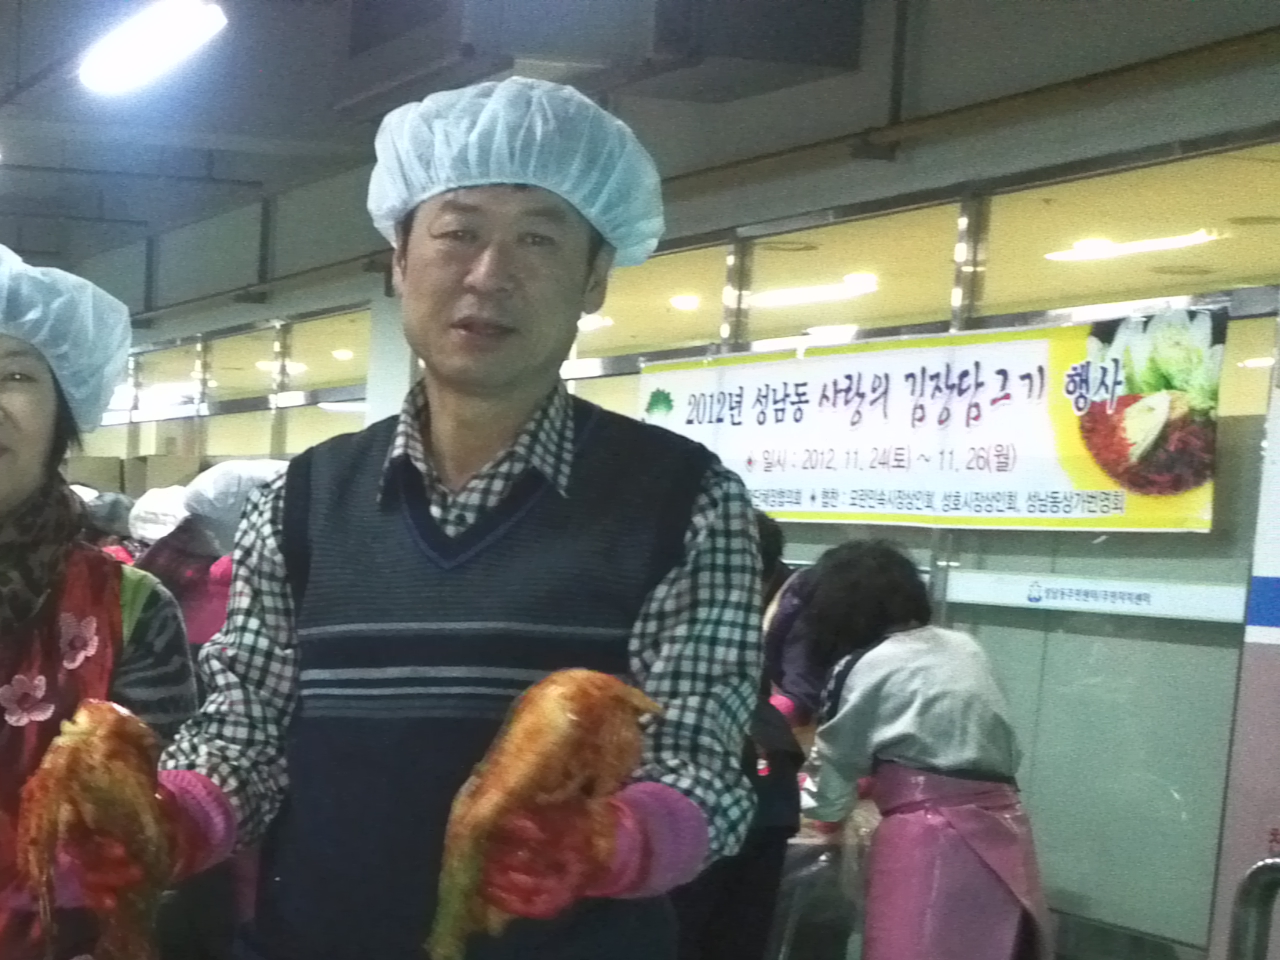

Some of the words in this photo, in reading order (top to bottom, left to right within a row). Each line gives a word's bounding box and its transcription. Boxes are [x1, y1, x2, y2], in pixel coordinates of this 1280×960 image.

[685, 386, 745, 426] 2012년
[752, 381, 810, 426] 성남동
[818, 371, 890, 428] 사랑의
[1064, 358, 1124, 414] 행사
[966, 443, 1017, 473] 26(월)
[1026, 490, 1125, 515] 성남동상가번영회
